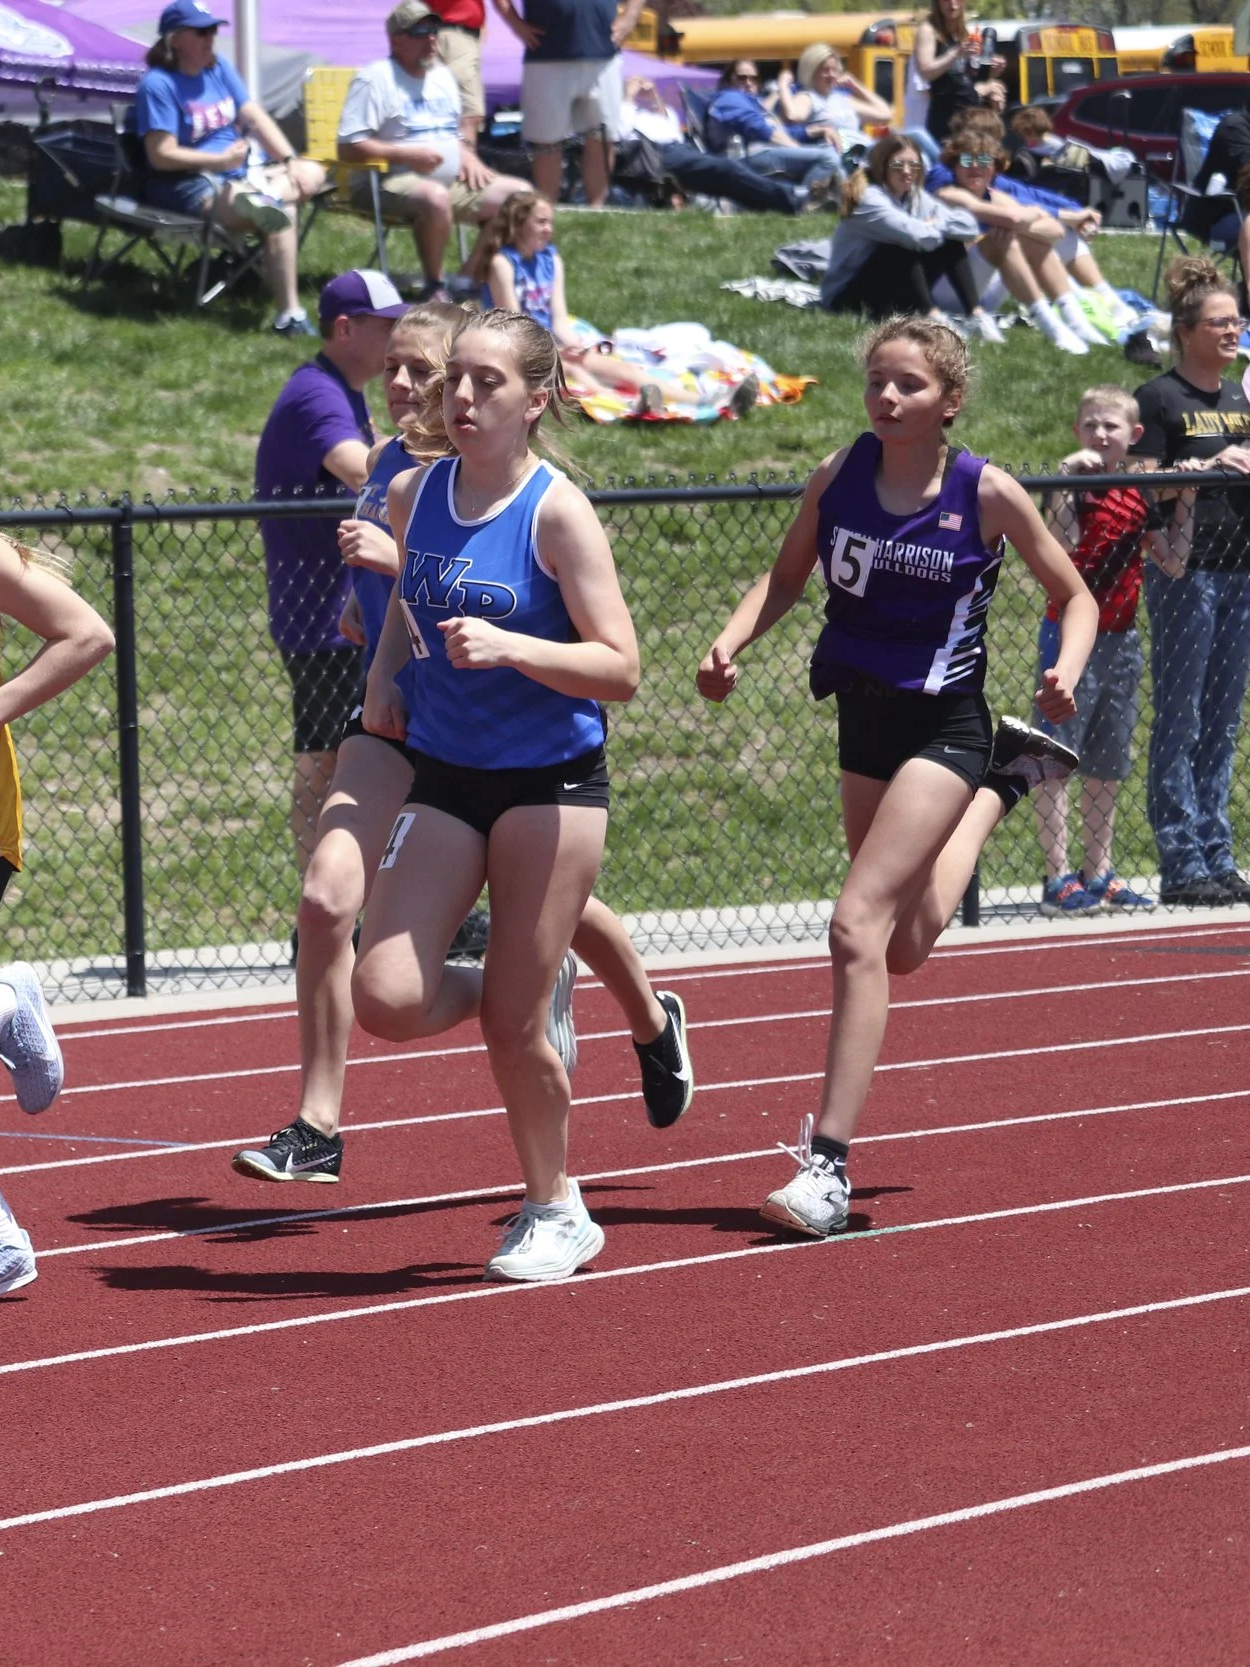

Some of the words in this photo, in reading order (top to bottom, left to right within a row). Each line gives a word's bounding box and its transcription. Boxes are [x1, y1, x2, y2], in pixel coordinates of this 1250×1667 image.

[838, 536, 867, 588] 5
[871, 558, 951, 583] ULLDOGS
[874, 538, 954, 572] HARRISON
